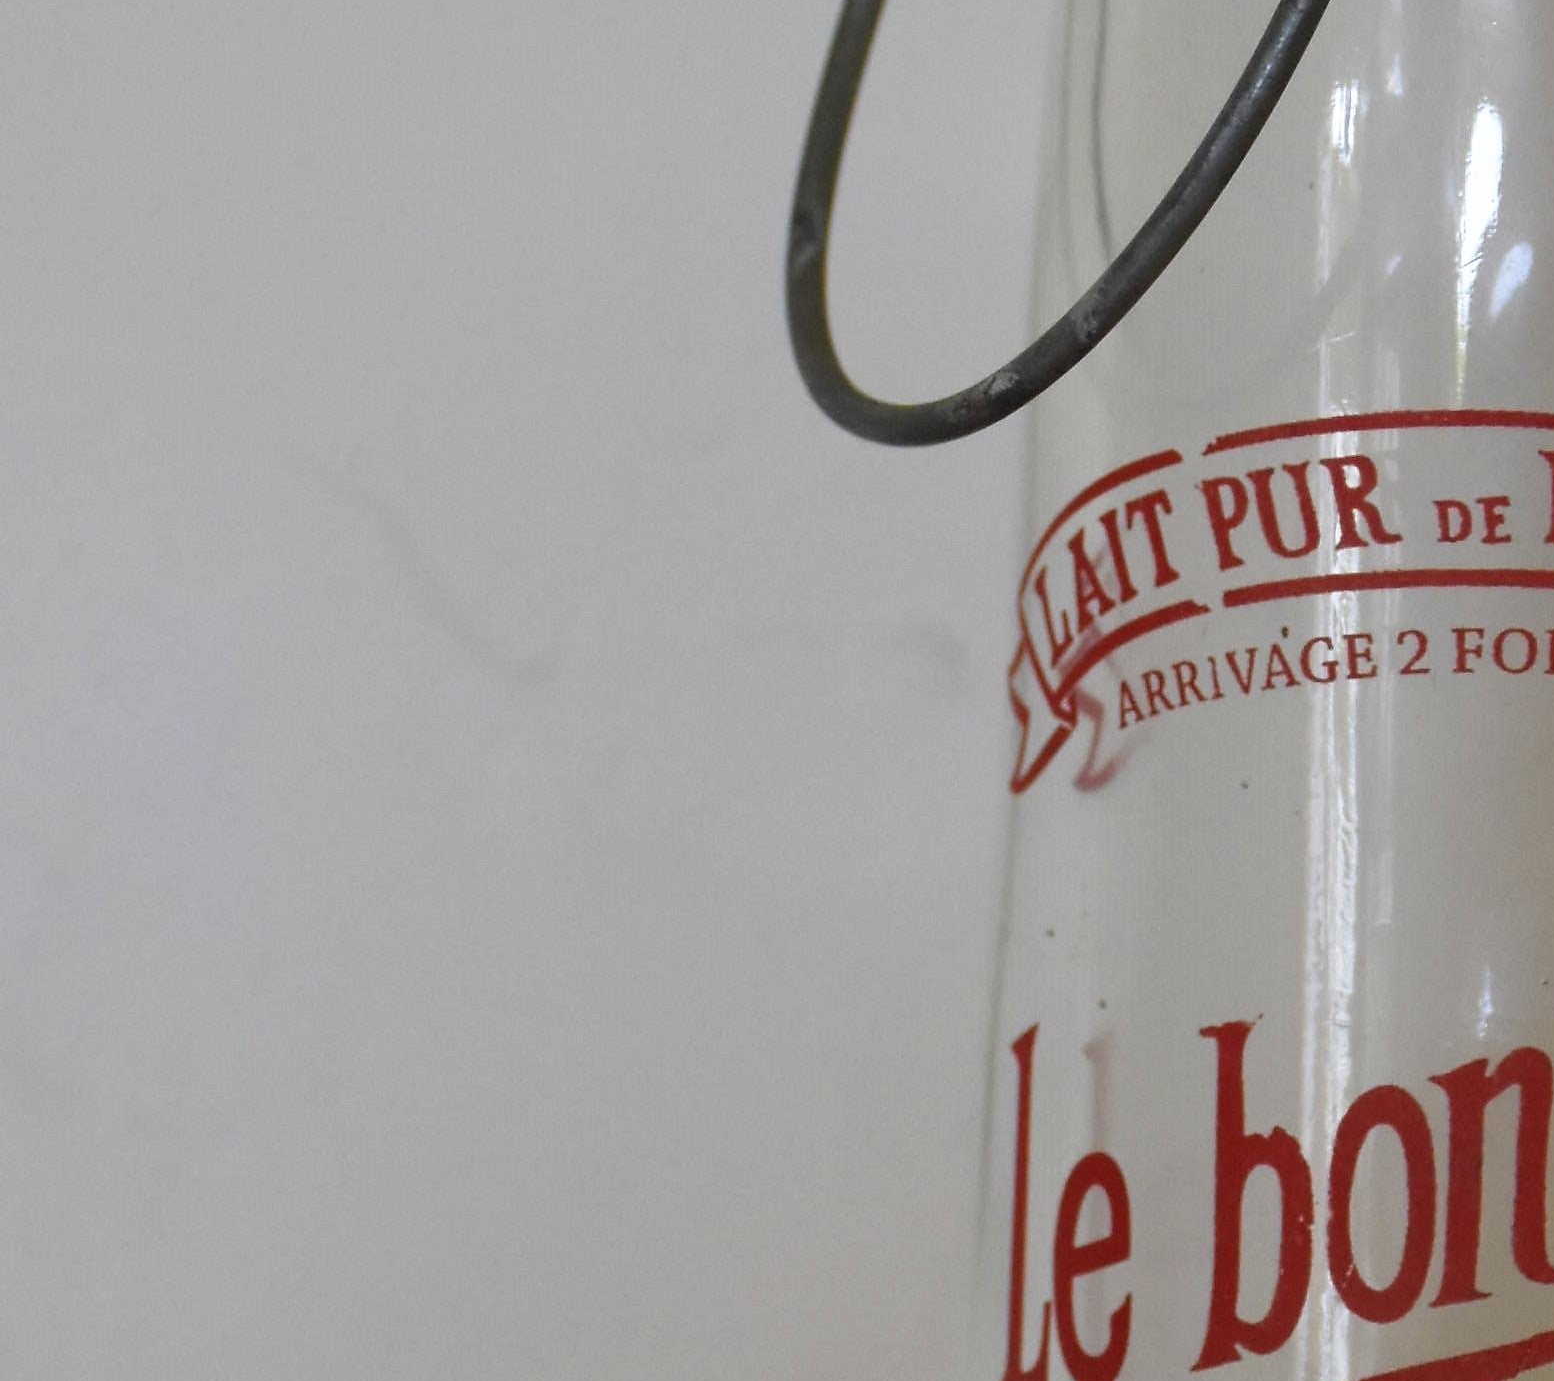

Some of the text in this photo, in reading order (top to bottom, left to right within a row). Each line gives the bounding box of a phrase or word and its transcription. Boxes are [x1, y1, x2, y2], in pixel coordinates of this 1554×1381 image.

[1032, 488, 1181, 669] LAIT
[1199, 454, 1403, 573] PUR
[1433, 495, 1513, 546] DE
[1118, 632, 1379, 729] ARRIVAGE
[1396, 629, 1431, 676] 2
